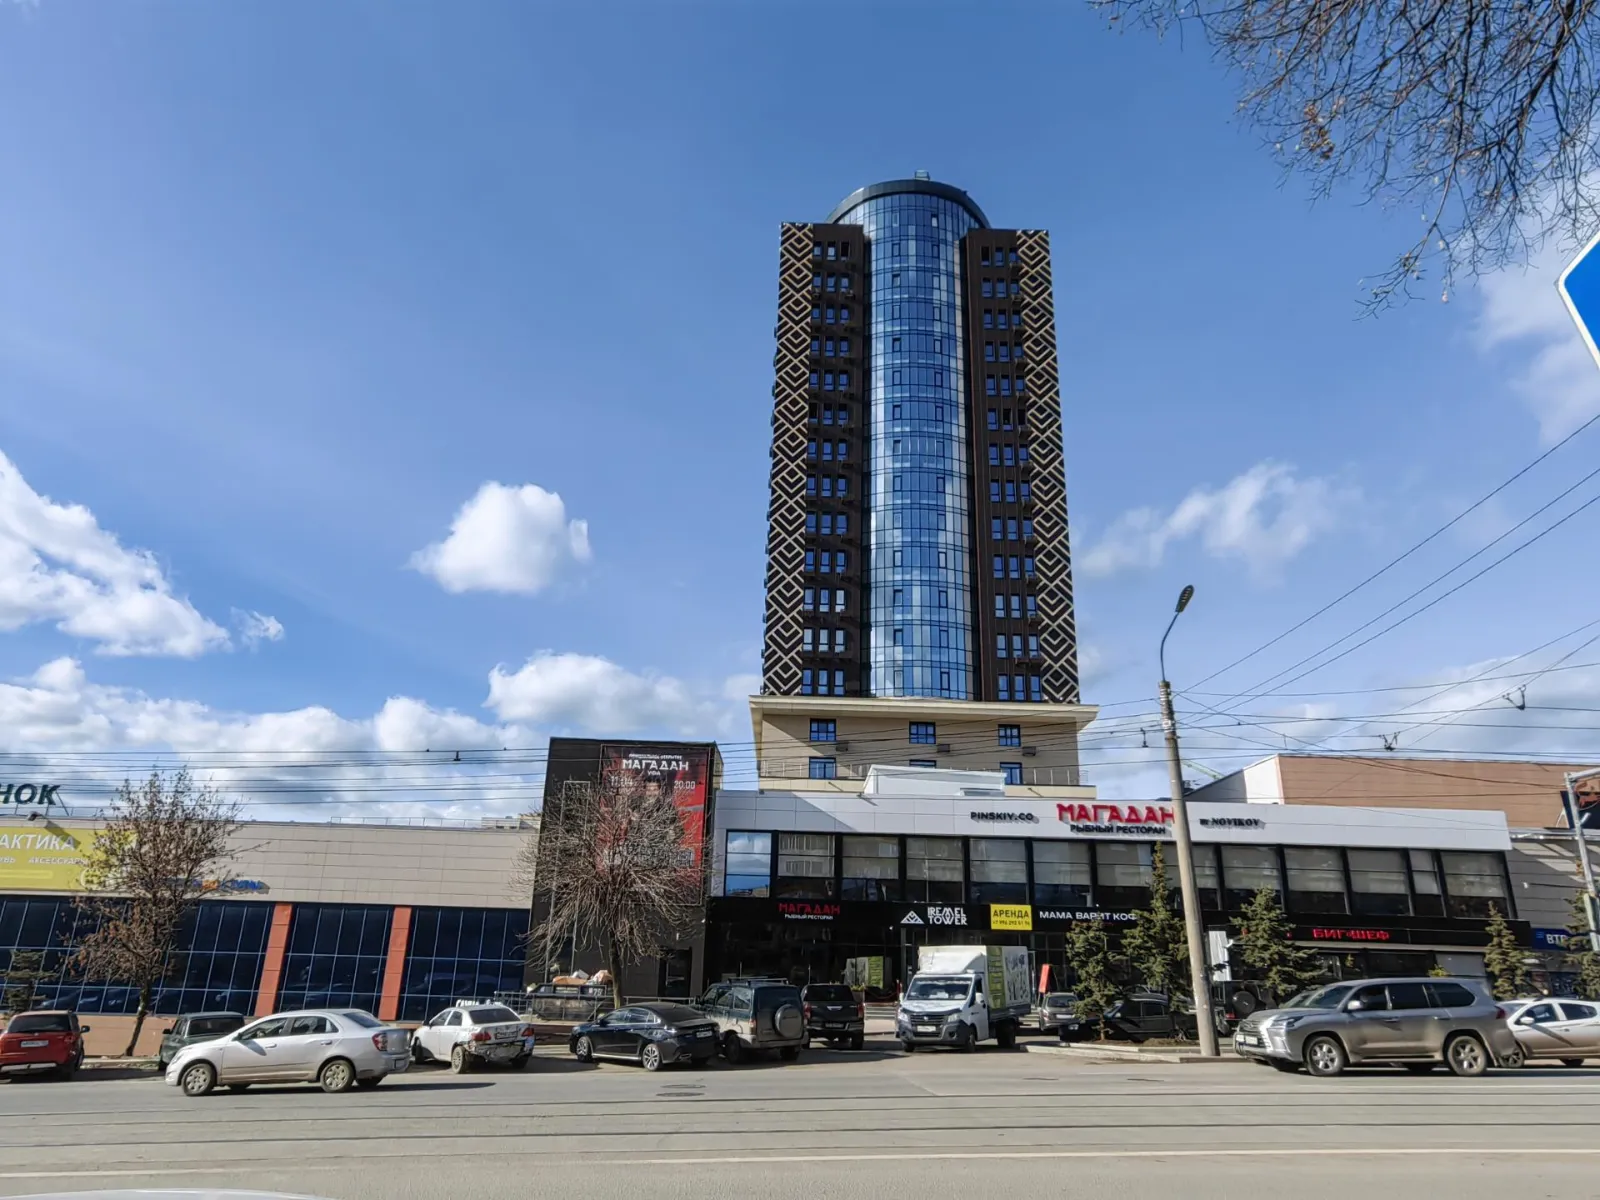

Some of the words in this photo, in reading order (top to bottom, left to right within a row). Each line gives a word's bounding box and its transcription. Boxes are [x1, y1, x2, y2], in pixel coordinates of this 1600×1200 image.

[622, 760, 689, 771] МАГАДАН
[970, 811, 1034, 821] PINSKIY.CO
[1057, 803, 1175, 824] МАГАДАН
[1070, 824, 1114, 834] РЫБНЫЙ
[1116, 825, 1166, 835] РЕСТОРАН
[779, 902, 840, 915] МАГАДАН
[992, 909, 1030, 919] АРЕНДА
[928, 915, 967, 926] TOWER
[1039, 911, 1073, 920] МАМА
